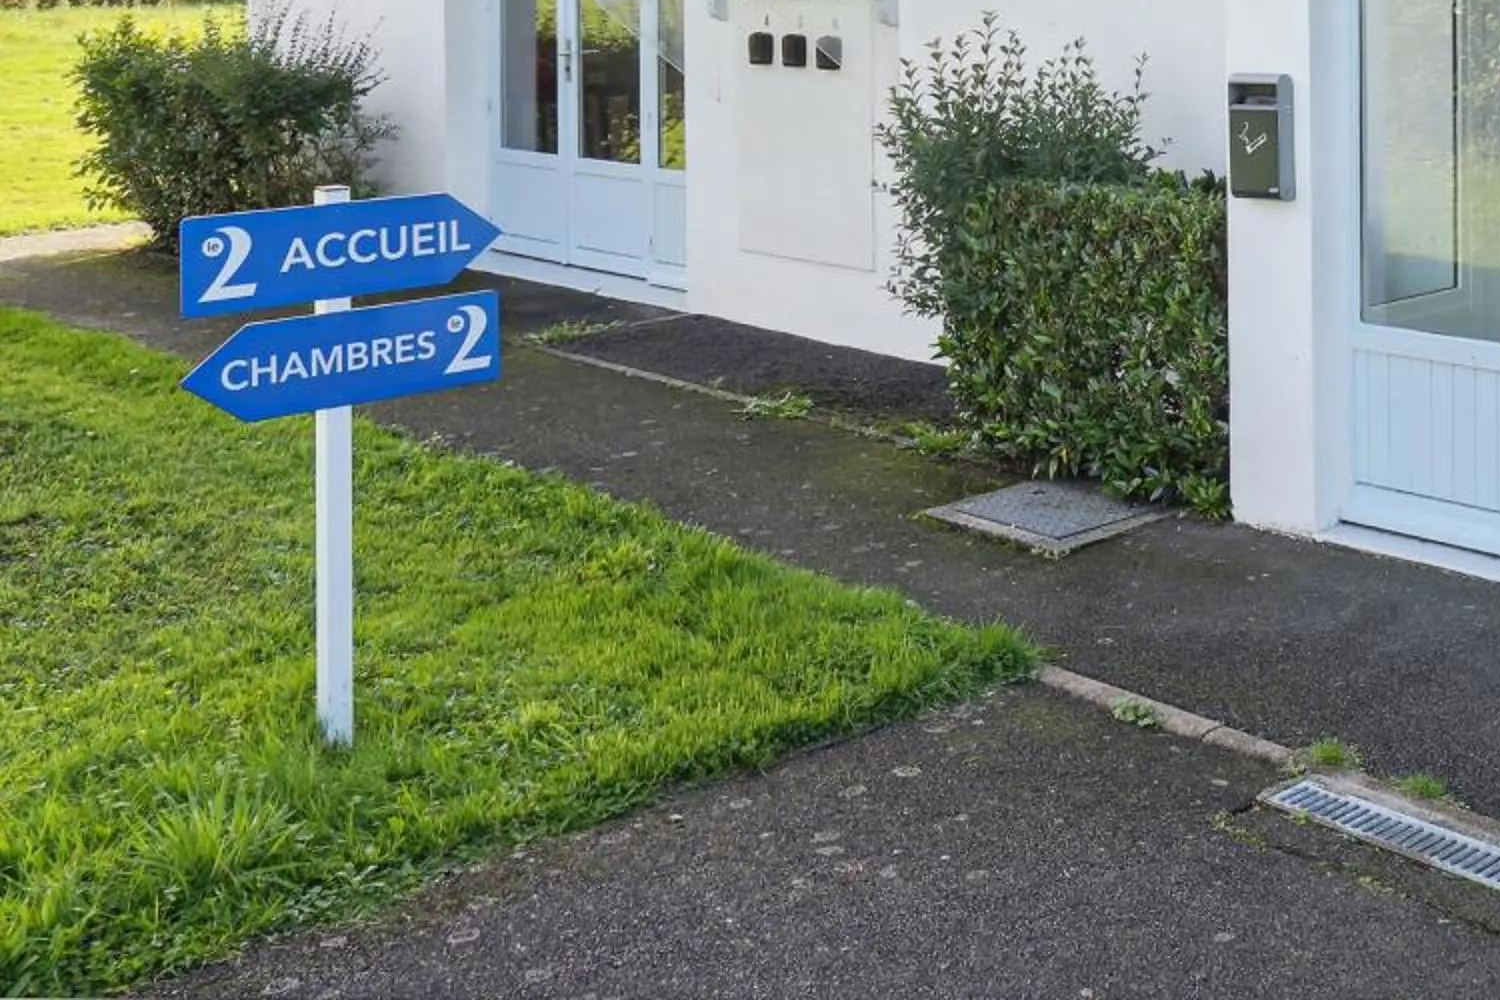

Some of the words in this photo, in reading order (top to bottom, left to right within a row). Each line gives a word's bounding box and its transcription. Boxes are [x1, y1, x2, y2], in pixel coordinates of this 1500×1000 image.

[197, 226, 257, 303] 2
[279, 220, 471, 274] ACCUEIL
[220, 331, 437, 391] CHAMBRES
[443, 305, 491, 375] 2
